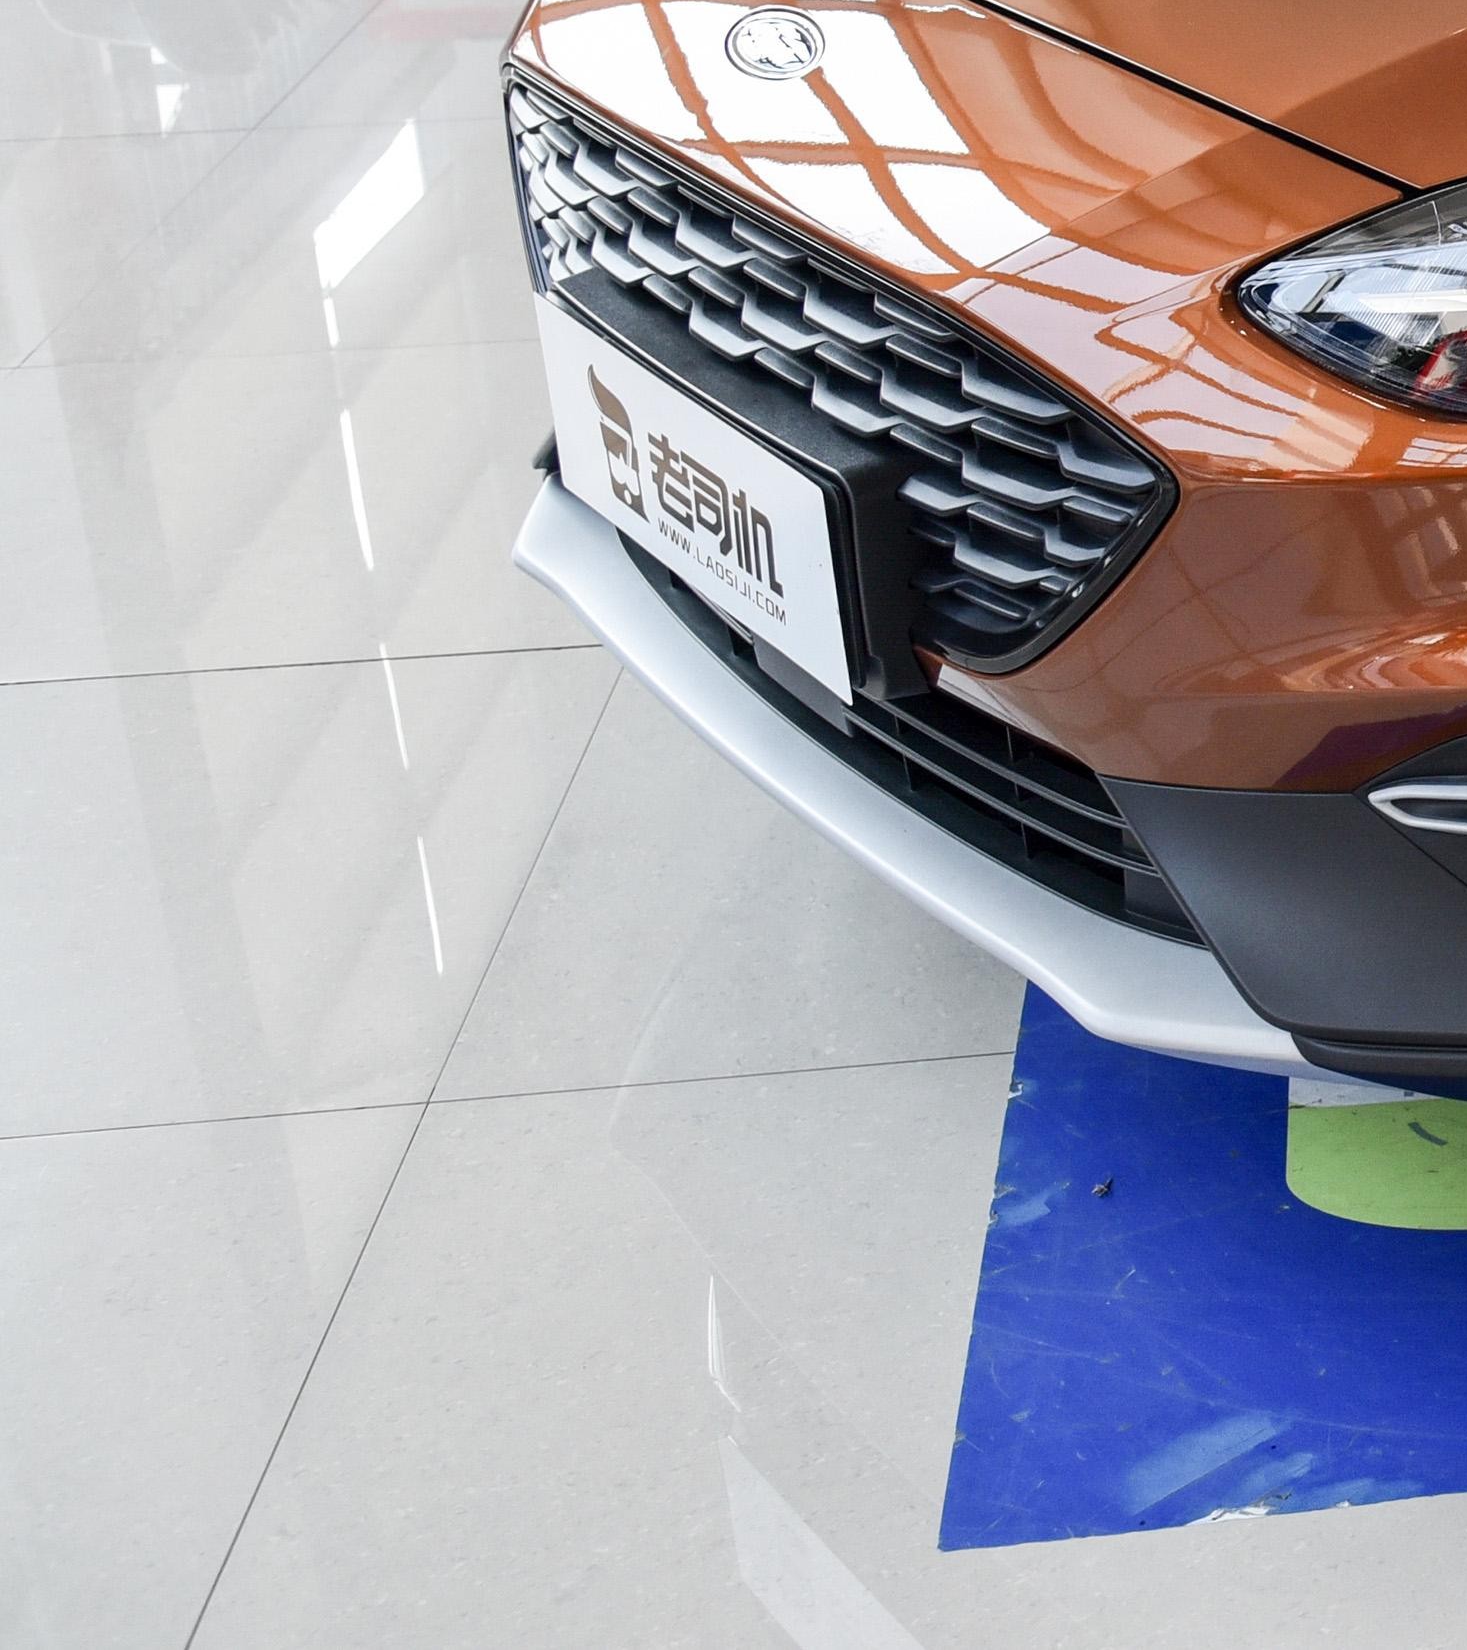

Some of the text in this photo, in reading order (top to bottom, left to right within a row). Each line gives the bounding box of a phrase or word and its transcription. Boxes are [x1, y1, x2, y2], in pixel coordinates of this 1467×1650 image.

[648, 432, 784, 599] 老司机
[657, 518, 787, 626] WWW.LAOSIJI.COM
